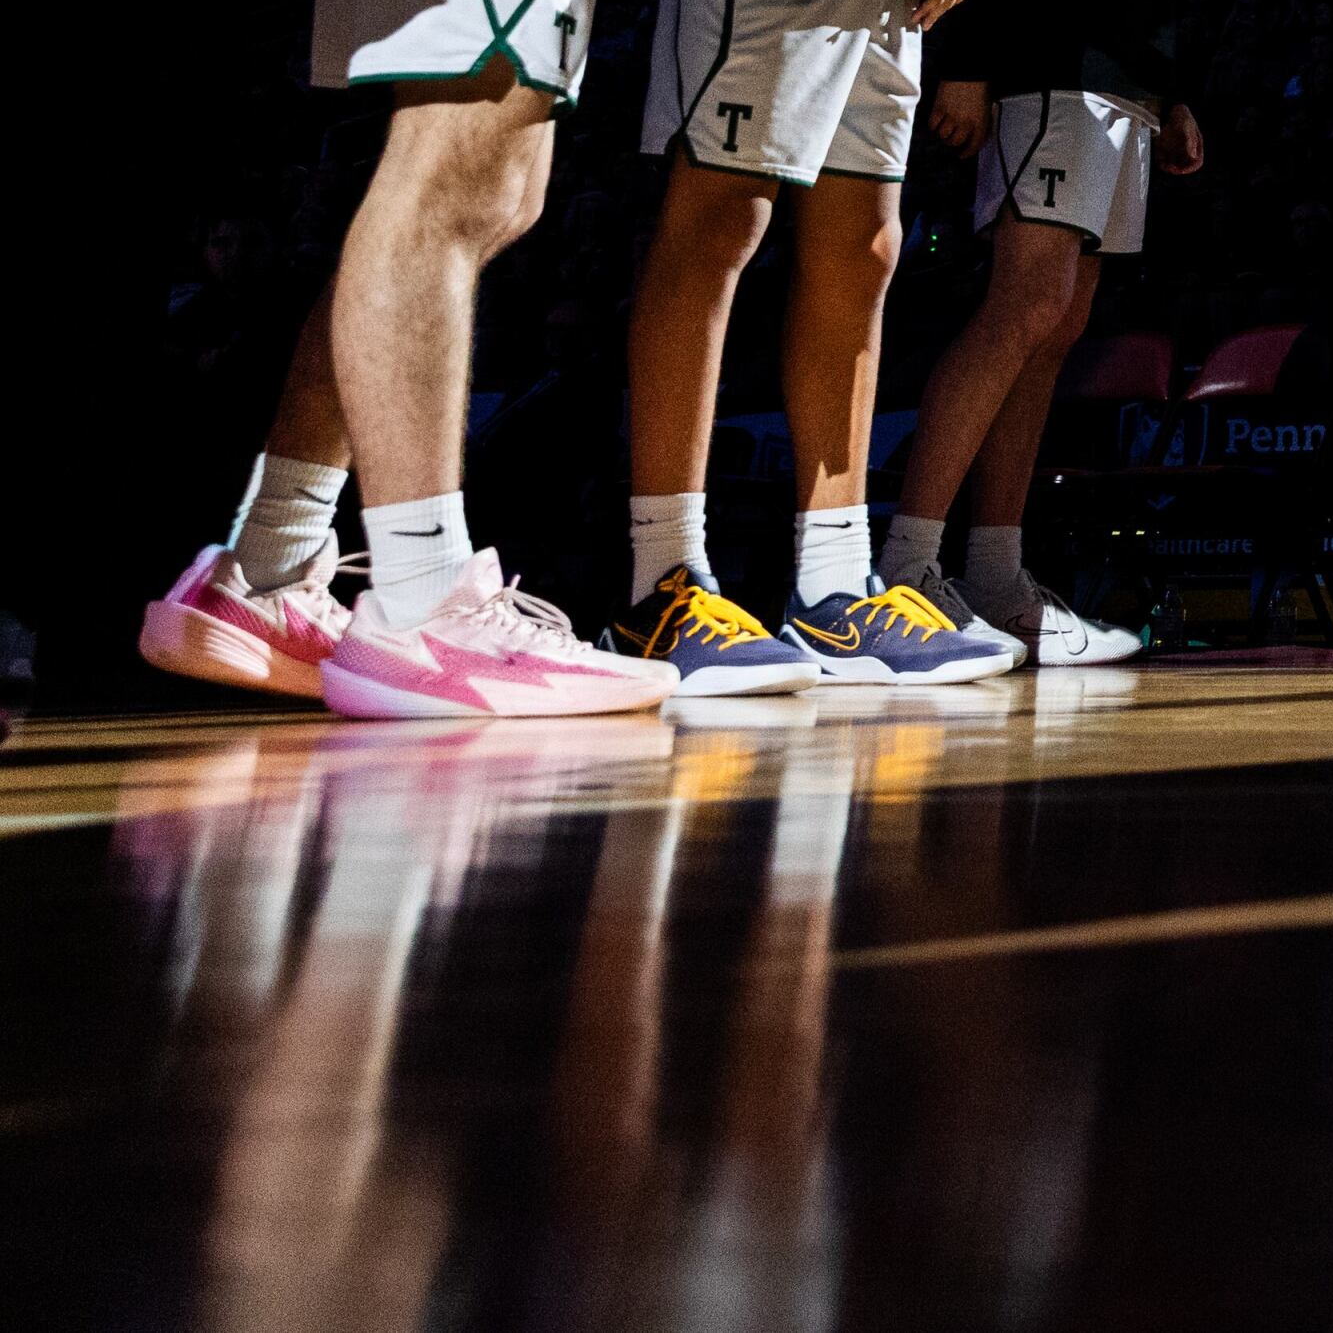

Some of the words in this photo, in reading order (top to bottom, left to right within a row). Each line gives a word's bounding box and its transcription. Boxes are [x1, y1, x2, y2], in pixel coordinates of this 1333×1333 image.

[554, 12, 577, 69] T
[717, 102, 753, 152] T
[1039, 168, 1066, 208] T
[1225, 418, 1326, 454] Penn
